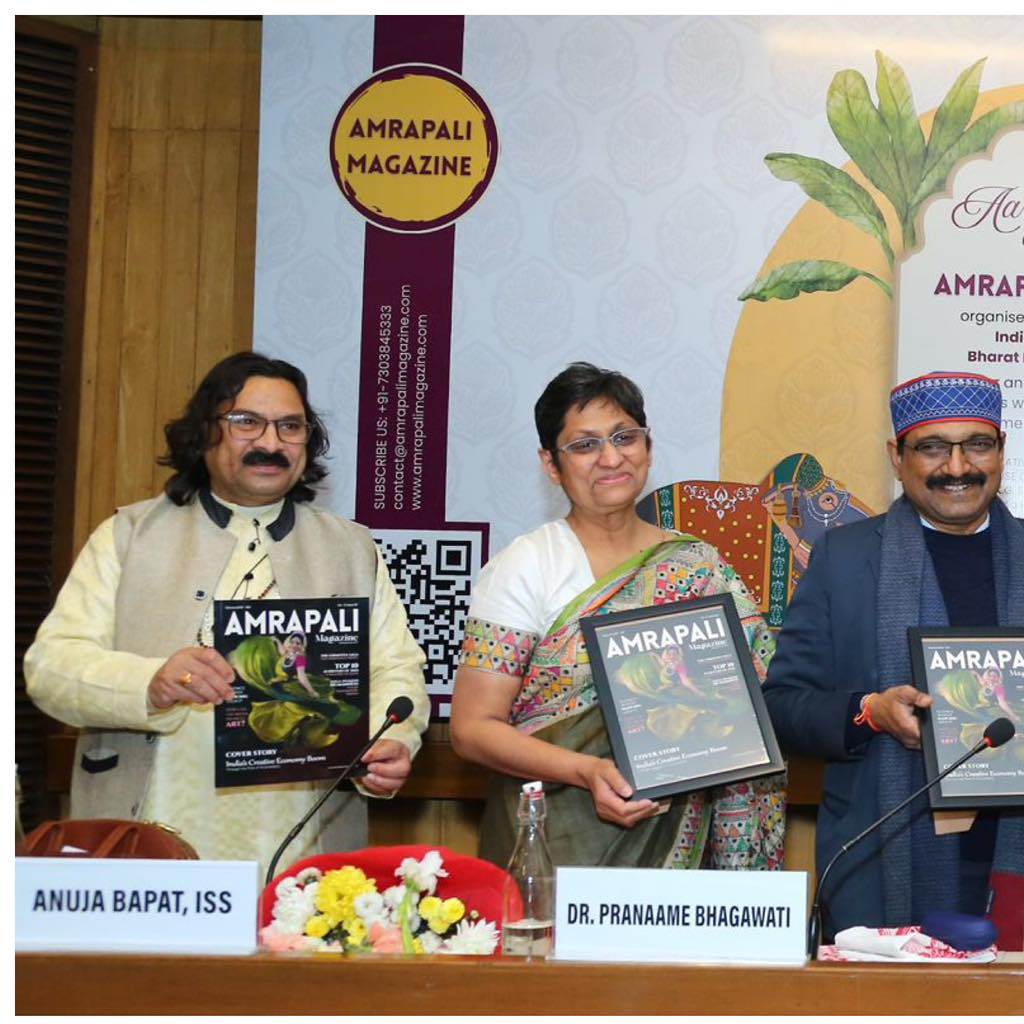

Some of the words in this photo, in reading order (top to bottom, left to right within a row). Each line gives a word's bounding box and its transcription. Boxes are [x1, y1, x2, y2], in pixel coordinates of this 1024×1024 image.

[349, 118, 471, 140] AMRAPALI
[347, 154, 471, 176] MAGAZINE
[377, 305, 392, 413] +91-7303845333
[968, 351, 1020, 363] Bharat
[394, 284, 411, 510] contact@amrapalimagazine.com
[1004, 379, 1023, 389] an
[376, 416, 388, 436] US:
[412, 314, 428, 511] www.amrapalimagazine.com
[374, 439, 387, 510] SUBSCRIBE
[224, 608, 359, 636] AMRAPALI
[607, 617, 726, 659] AMRAPALI
[33, 889, 105, 912] ANUJA
[113, 890, 188, 916] BAPAT,
[196, 891, 232, 913] ISS
[568, 903, 594, 925] DR.
[600, 903, 690, 926] PRANAAME
[695, 905, 791, 928] BHAGAWATI
